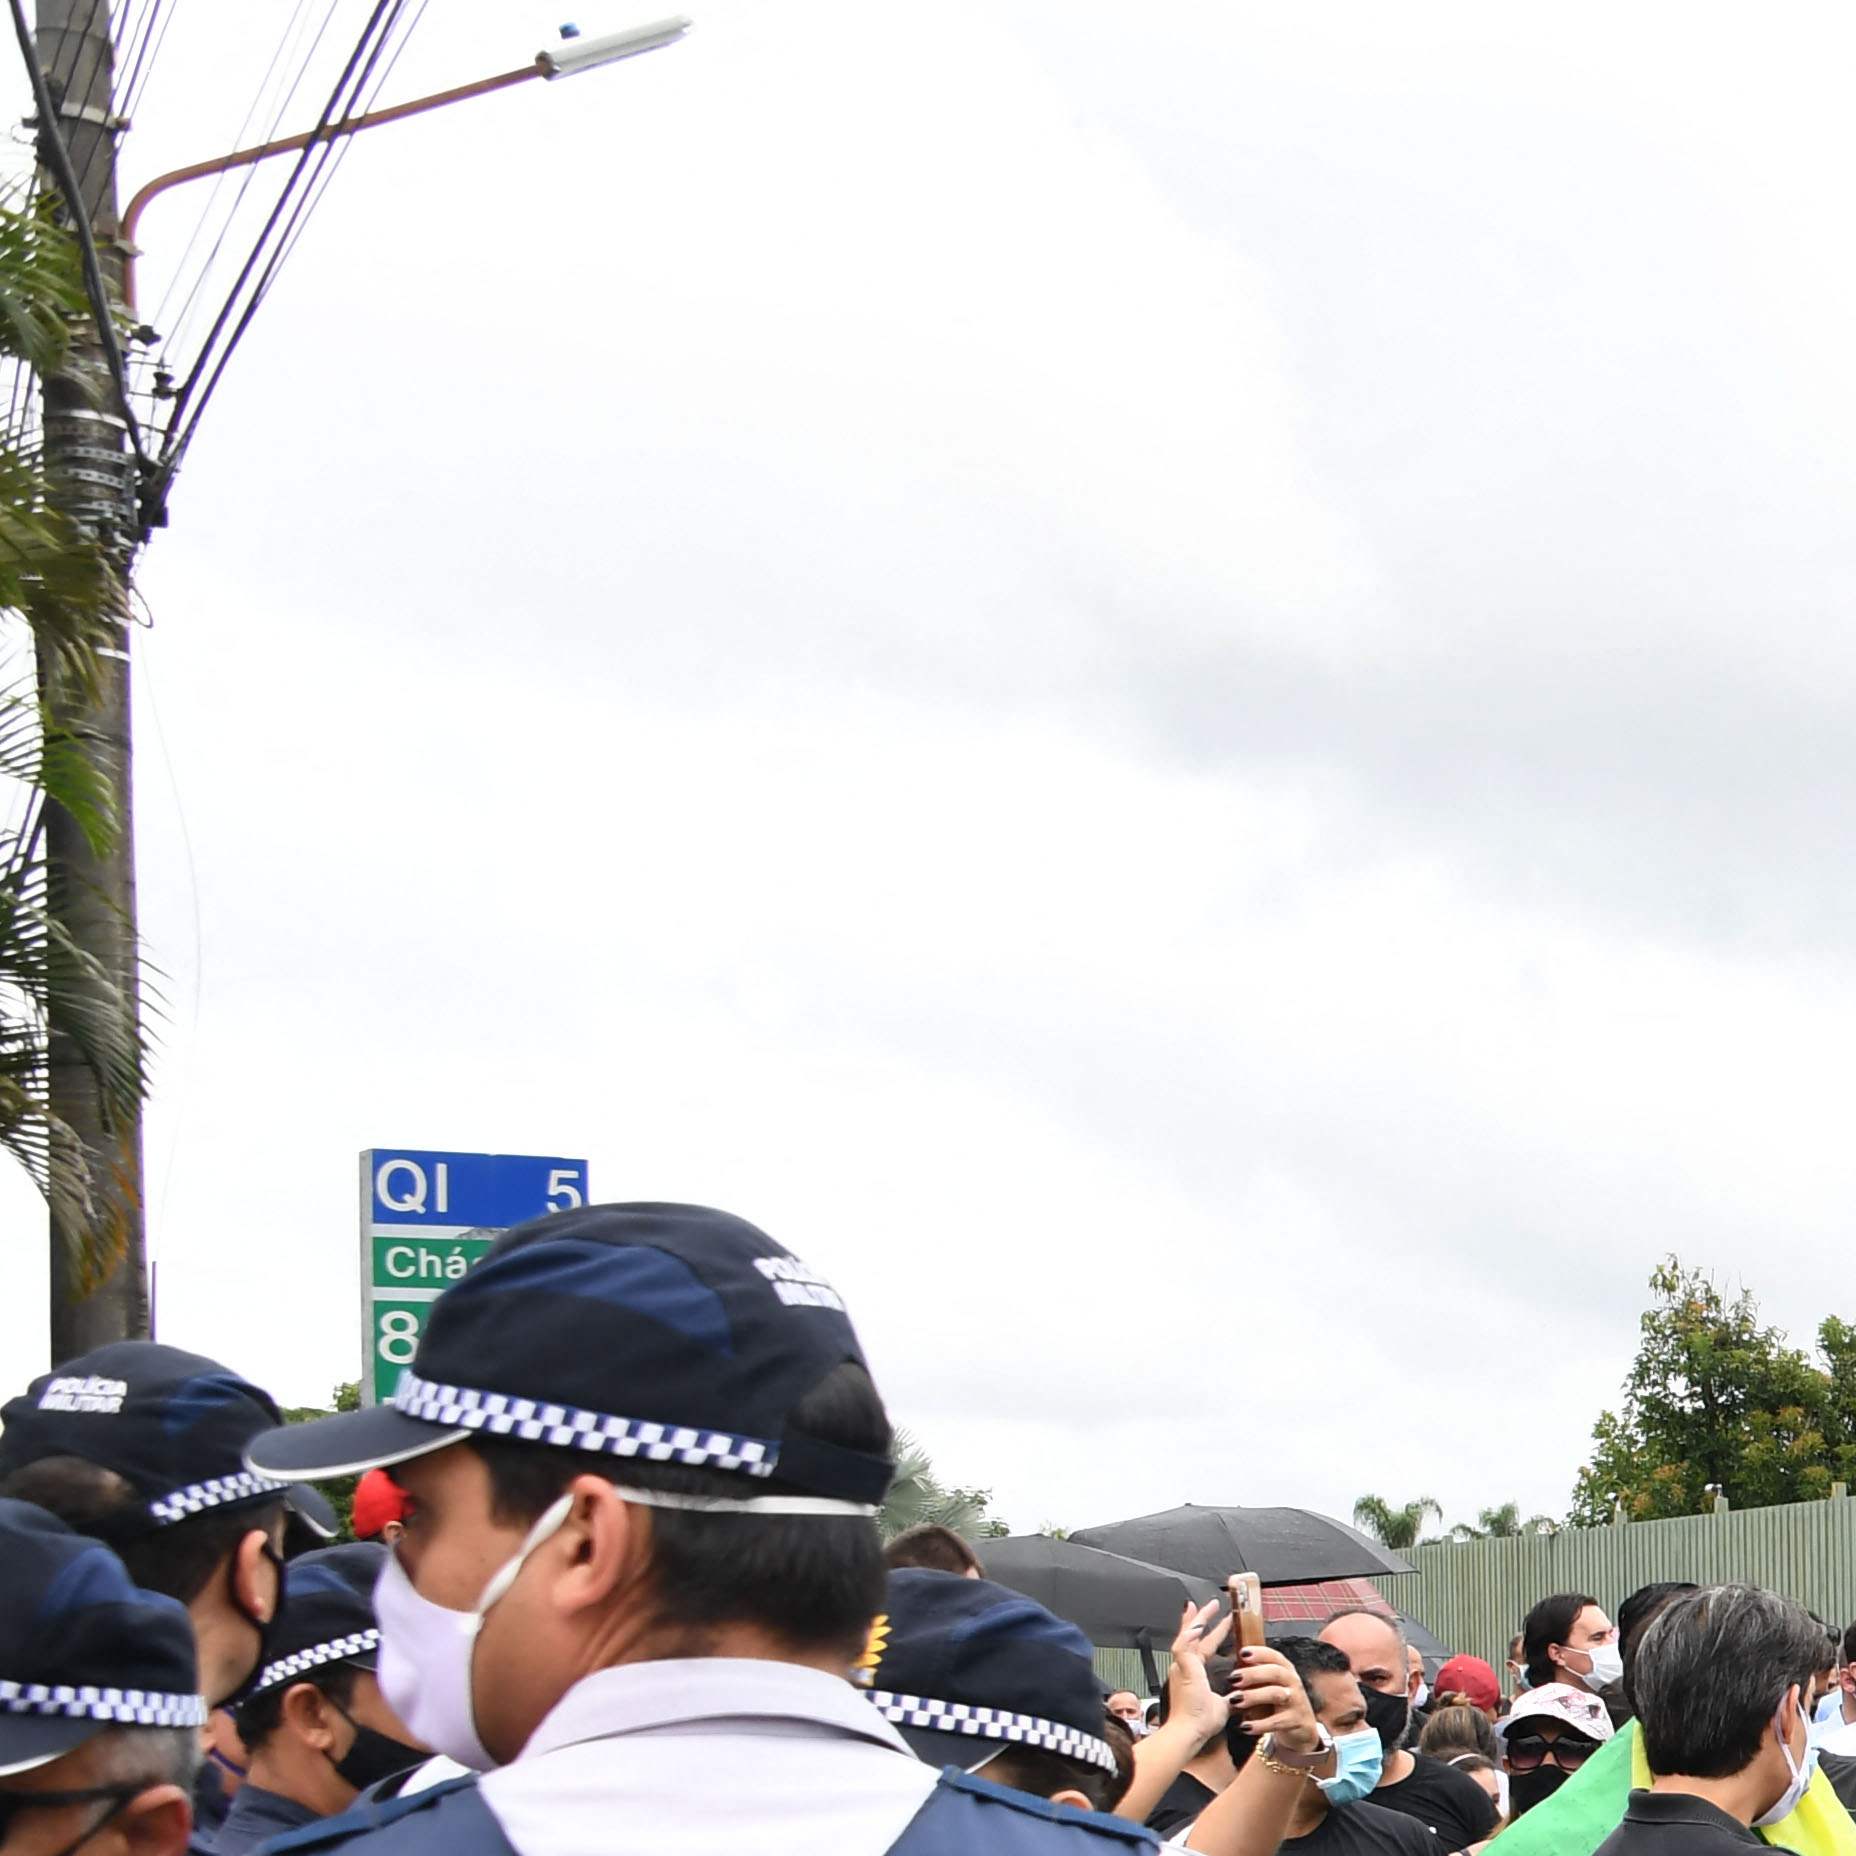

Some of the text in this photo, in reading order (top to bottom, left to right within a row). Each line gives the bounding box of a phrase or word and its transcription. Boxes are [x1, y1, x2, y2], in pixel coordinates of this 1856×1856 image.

[376, 1158, 582, 1214] QI 5
[384, 1245, 484, 1280] Chá
[378, 1309, 420, 1365] 8
